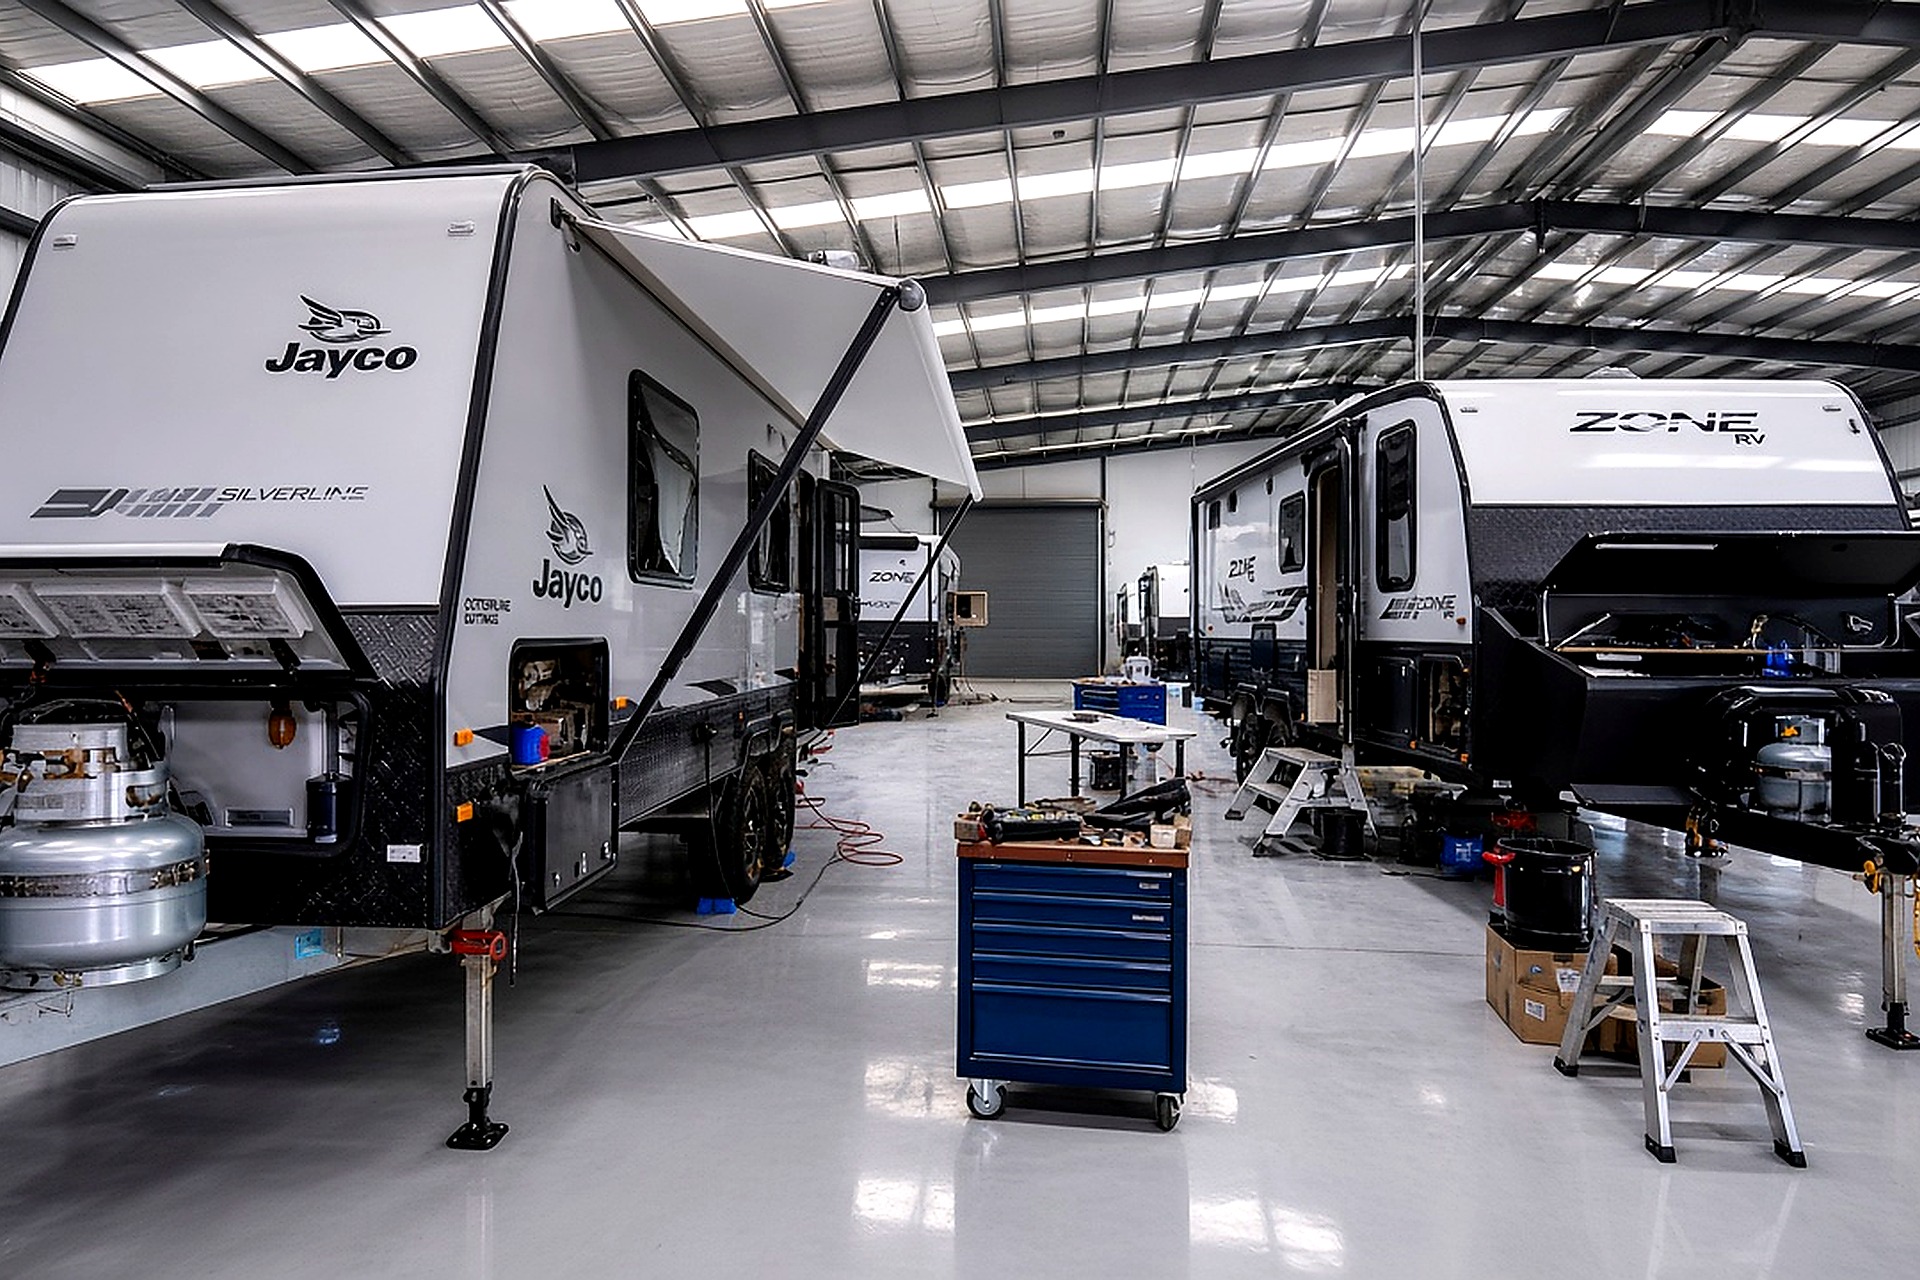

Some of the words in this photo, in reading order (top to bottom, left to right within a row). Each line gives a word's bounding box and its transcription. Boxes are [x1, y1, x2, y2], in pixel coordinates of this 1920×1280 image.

[265, 342, 418, 379] Jayco
[1569, 412, 1760, 433] ZONE
[1735, 433, 1766, 445] RV
[216, 486, 369, 501] SILVERLINE
[532, 558, 603, 609] Jayco
